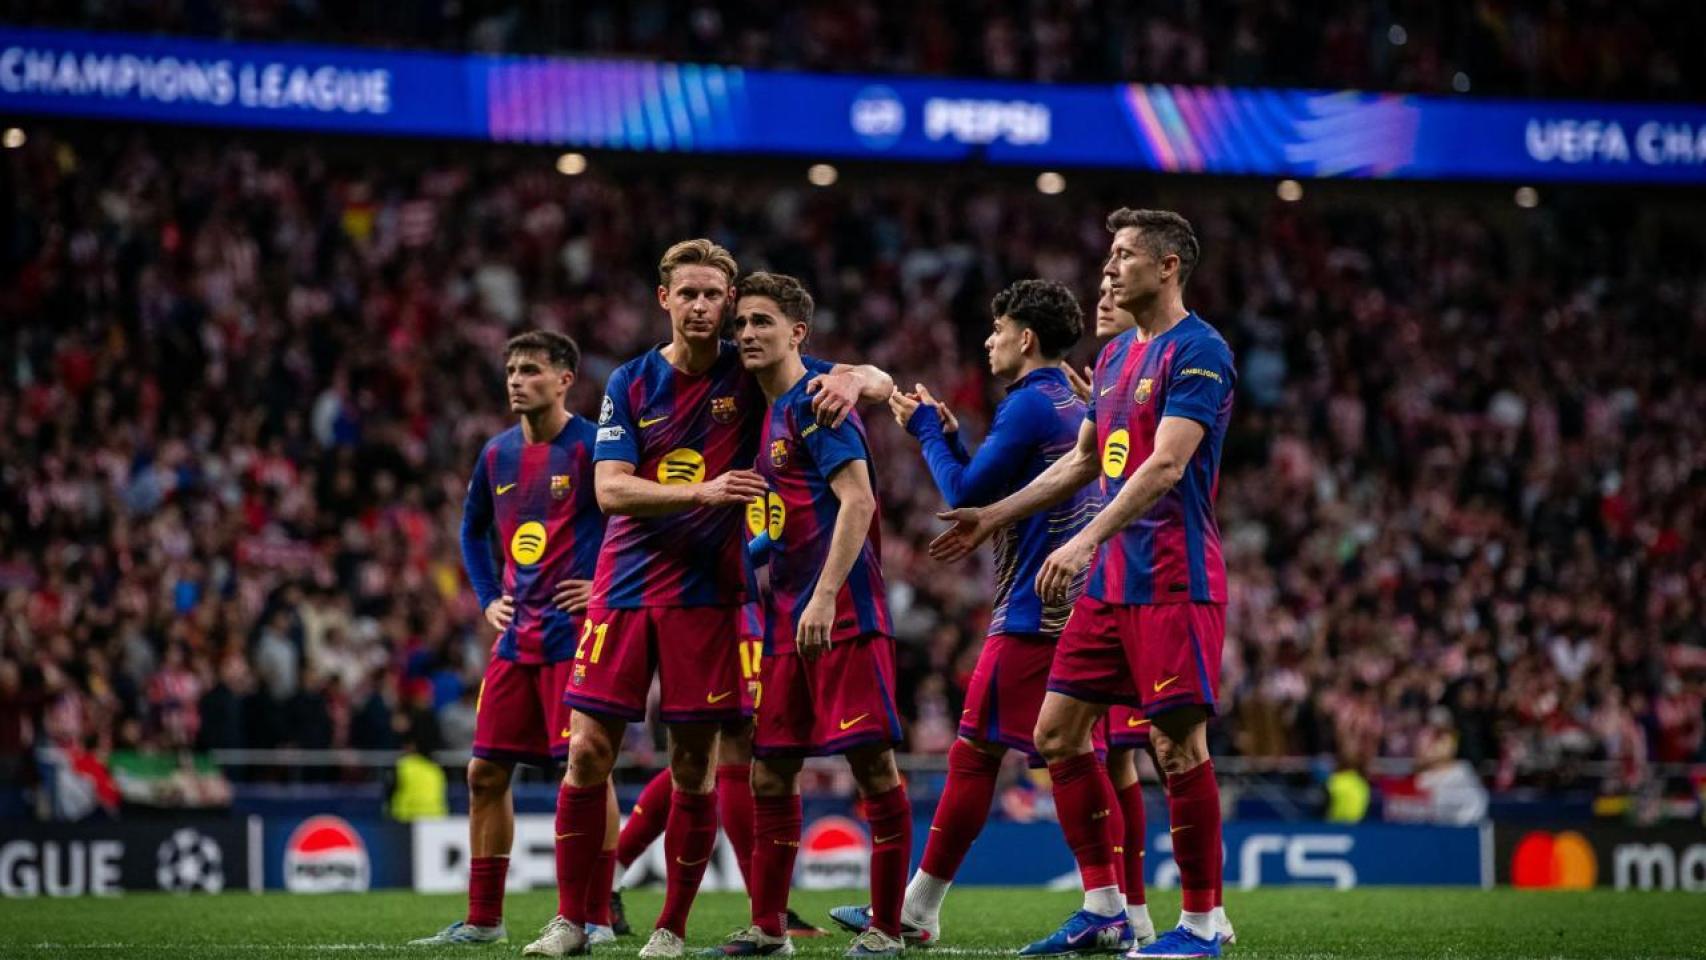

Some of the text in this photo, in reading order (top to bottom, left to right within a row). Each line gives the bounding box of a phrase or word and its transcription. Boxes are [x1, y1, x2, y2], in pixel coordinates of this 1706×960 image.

[0, 48, 391, 115] CHAMPIONS LEAGUE
[924, 97, 1050, 145] PEPSI
[1525, 117, 1631, 163] UEFA
[575, 618, 608, 664] 21
[0, 838, 124, 896] GUE
